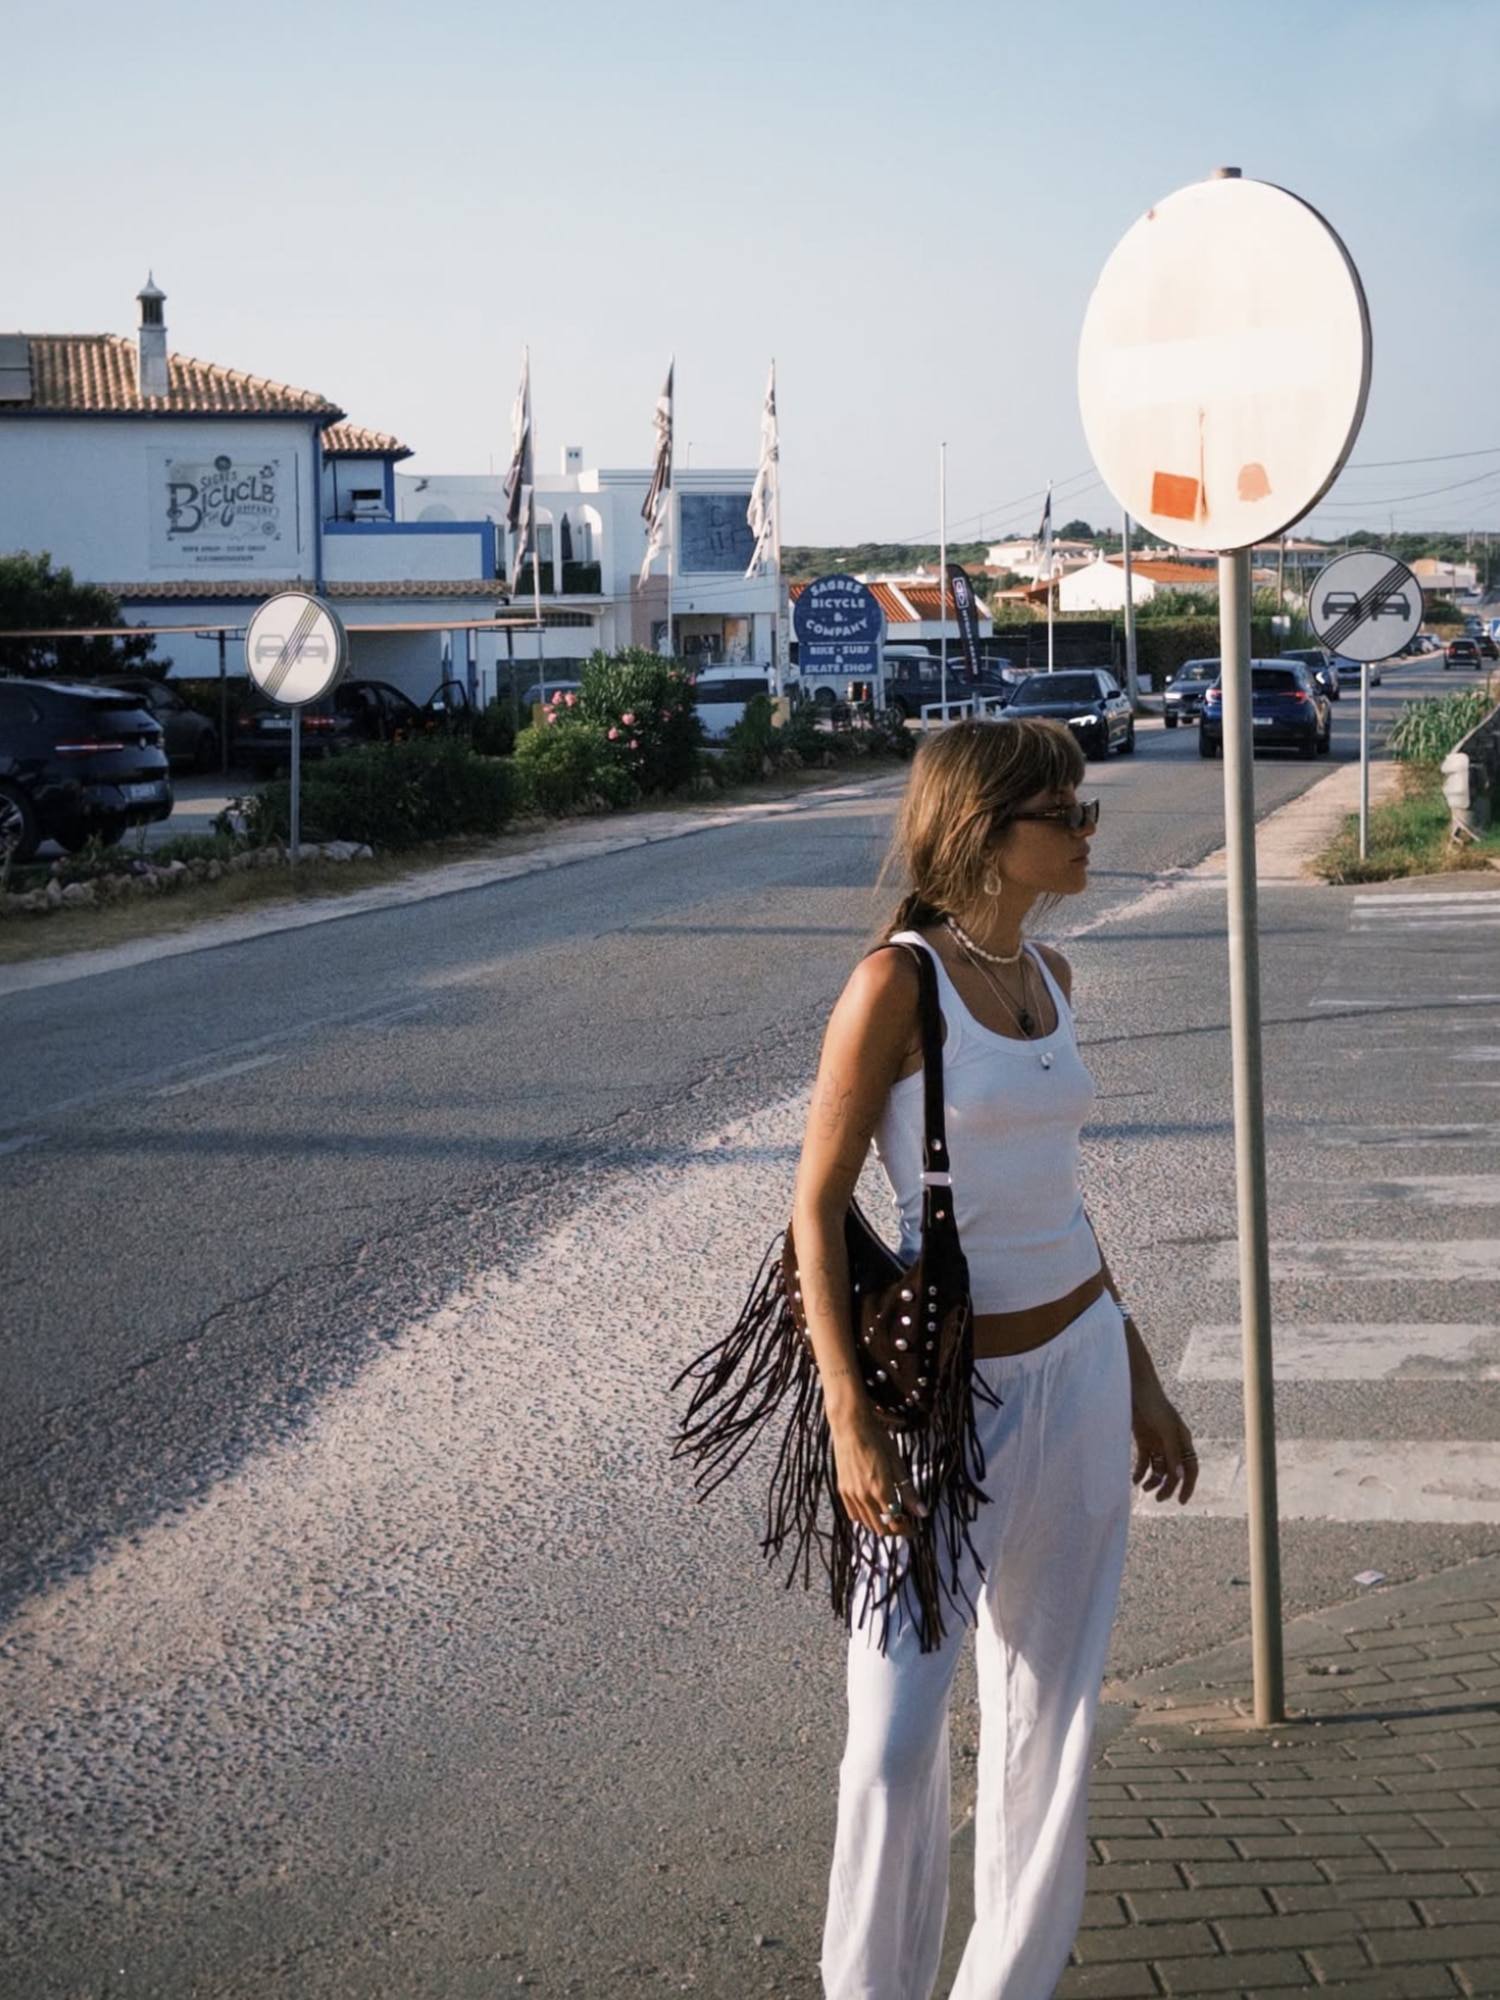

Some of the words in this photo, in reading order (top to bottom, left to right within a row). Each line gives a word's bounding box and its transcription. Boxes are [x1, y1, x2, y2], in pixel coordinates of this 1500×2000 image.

[810, 580, 863, 597] SAGRES
[810, 598, 866, 609] BICYCLE
[805, 618, 868, 637] COMPANY
[809, 646, 835, 655] BIKE
[842, 645, 870, 654] SURF
[804, 663, 841, 673] SKATE
[843, 663, 874, 673] SHOP
